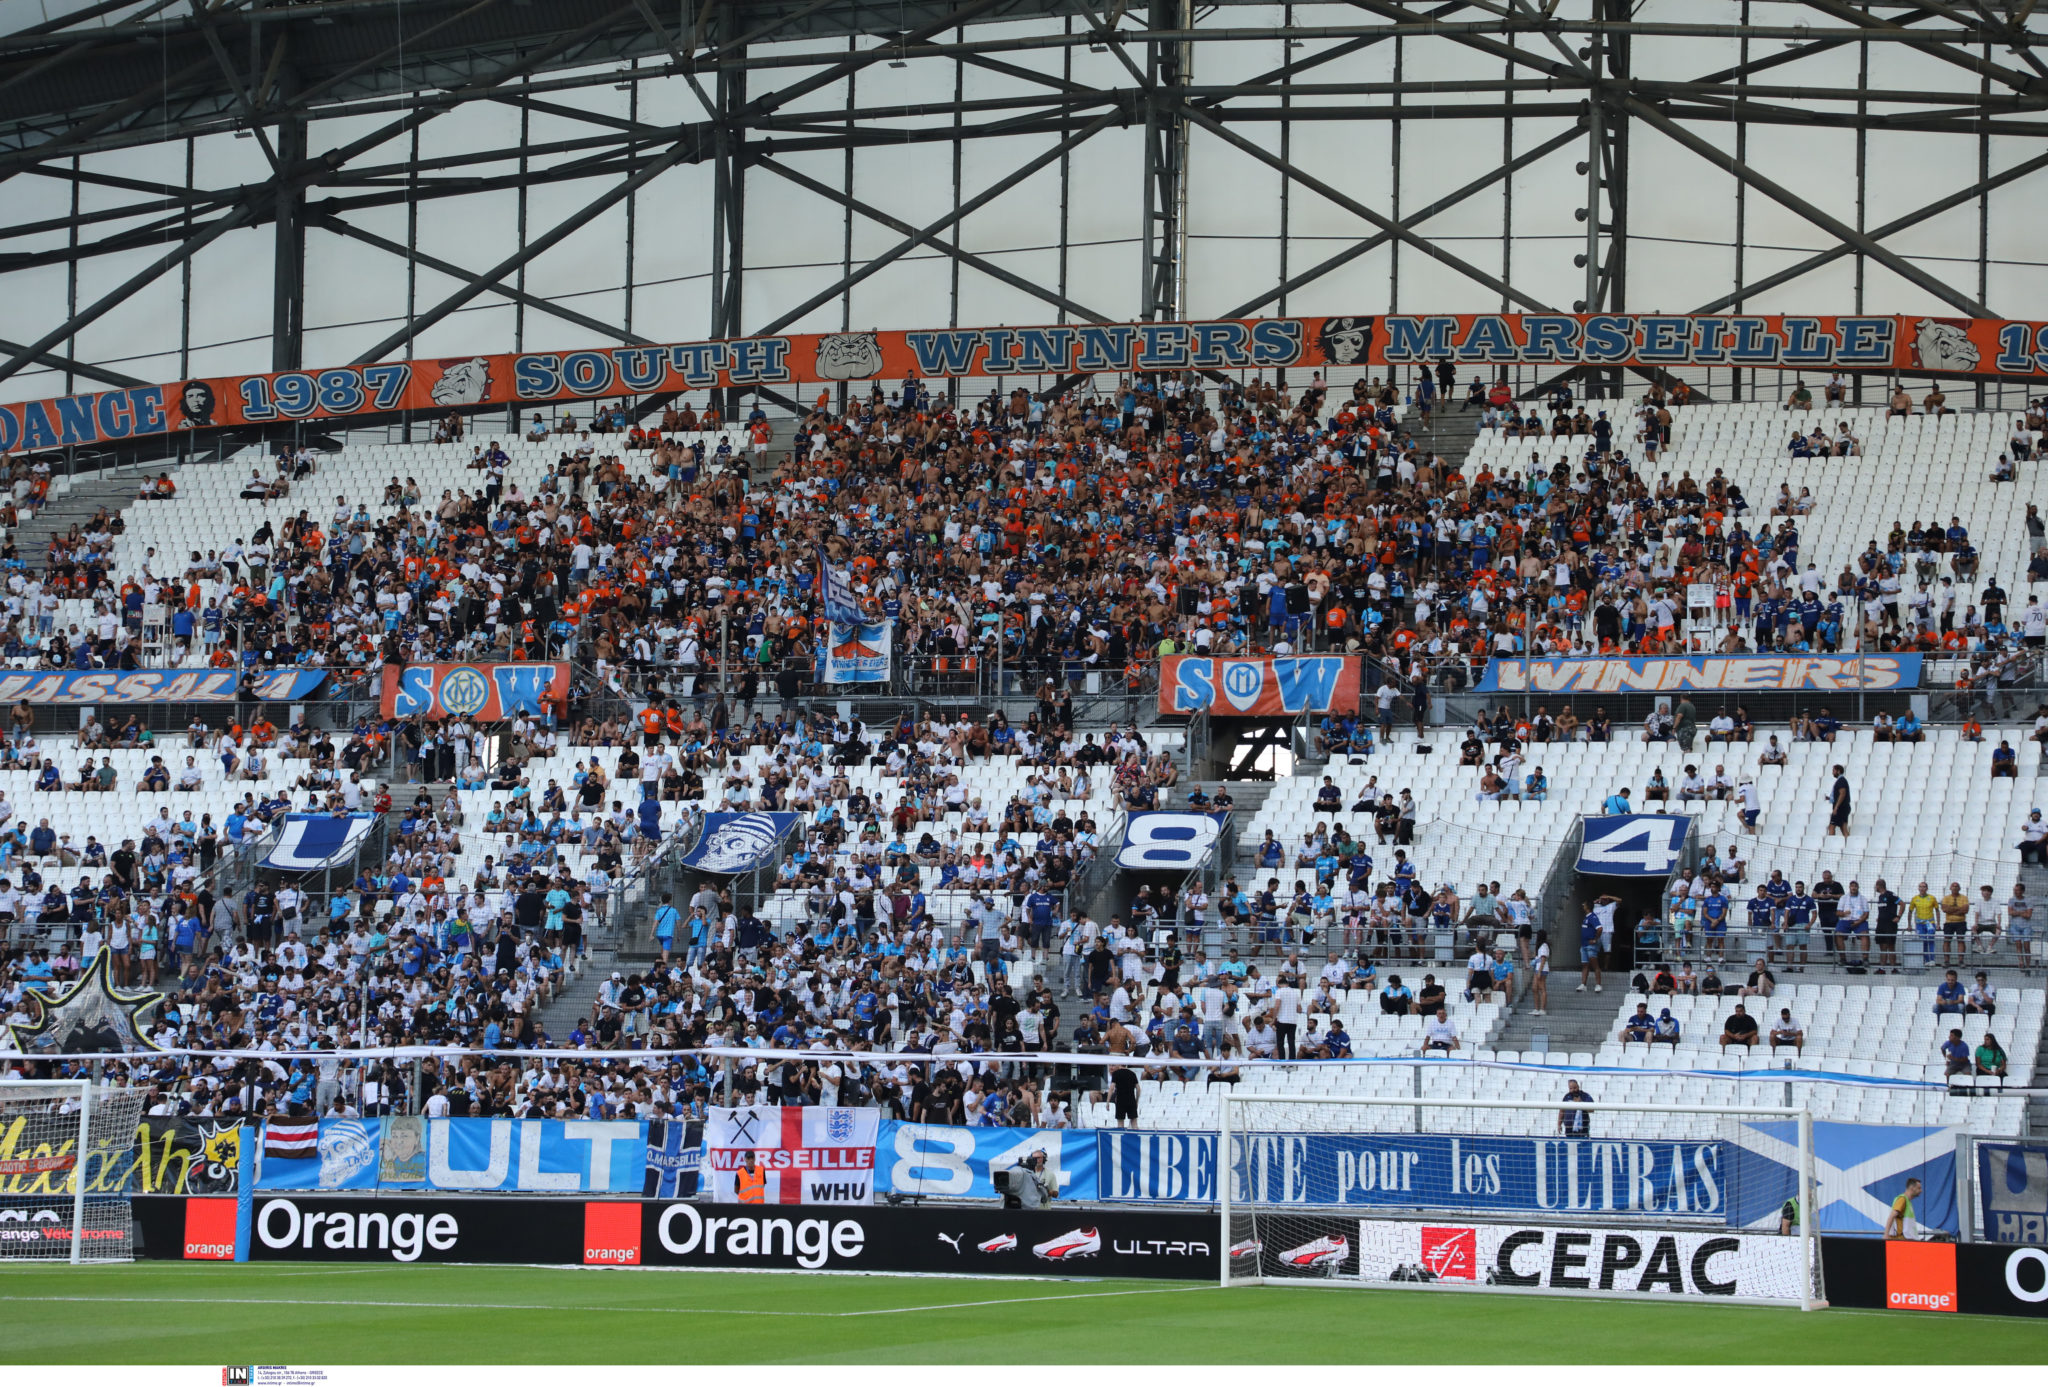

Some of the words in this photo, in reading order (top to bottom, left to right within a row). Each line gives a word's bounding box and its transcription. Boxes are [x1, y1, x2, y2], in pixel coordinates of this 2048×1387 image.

[514, 336, 791, 400] SOUTH
[906, 320, 1303, 377] WINNERS
[1382, 315, 1897, 364] MARSEILLE
[239, 362, 411, 421] 1987
[394, 666, 434, 718] S
[492, 664, 556, 720] W
[1174, 657, 1217, 712] S
[1272, 656, 1344, 713] W
[1498, 656, 1902, 691] WINNERS
[1117, 812, 1219, 868] 8
[1582, 817, 1682, 871] 4
[428, 1119, 639, 1190] ULT
[711, 1148, 872, 1170] MARSEILLE
[890, 1123, 1071, 1195] 84
[1336, 1149, 1419, 1203] pour
[1450, 1138, 1500, 1195] les
[1532, 1140, 1721, 1213] ULTRAS
[811, 1182, 865, 1201] WHU
[186, 1243, 233, 1257] orange
[257, 1198, 459, 1262] Orange
[586, 1248, 634, 1262] orange
[658, 1203, 865, 1269] Orange
[1113, 1239, 1210, 1257] ULTRA
[1496, 1229, 1741, 1296] CEPAC
[1890, 1292, 1950, 1309] orange
